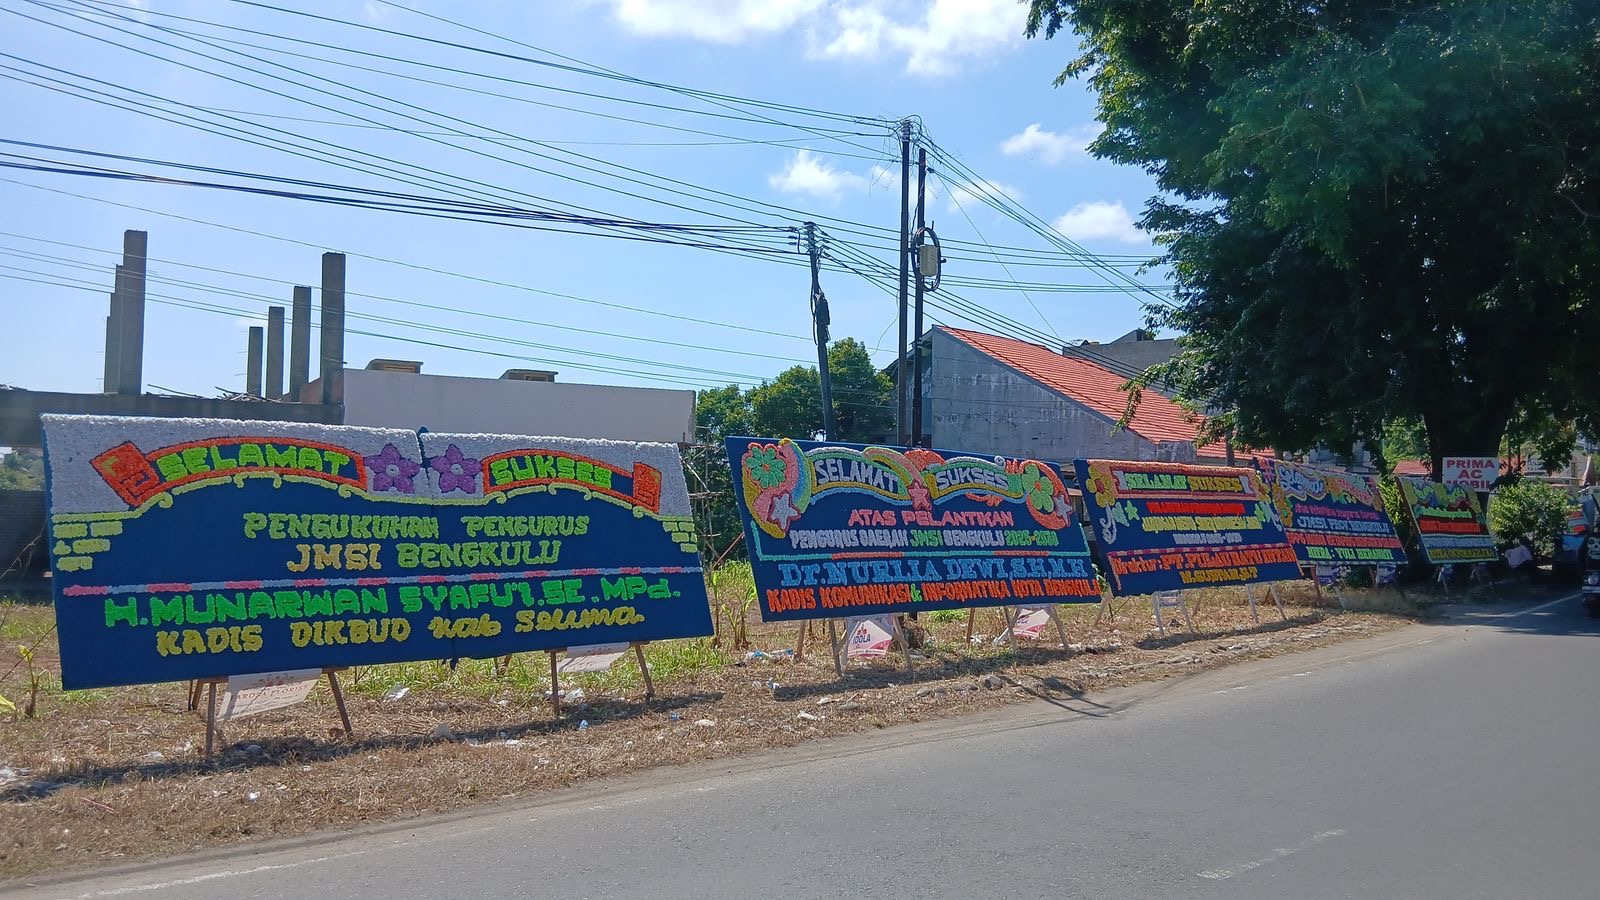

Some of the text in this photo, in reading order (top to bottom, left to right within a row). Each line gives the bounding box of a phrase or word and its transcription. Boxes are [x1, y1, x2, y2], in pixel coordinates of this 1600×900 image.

[156, 443, 612, 489] SELAMAT SUKSES
[814, 459, 1009, 493] SELAMAT SUKSES
[1446, 460, 1495, 468] PRIMA
[1457, 469, 1482, 479] AC
[243, 512, 590, 539] PENGUKUHAN PENGURUS
[848, 509, 1014, 526] ATAS PELANTIKAN
[789, 530, 859, 549] PENGURUS
[859, 529, 909, 548] DAERAH
[910, 529, 943, 547] JMSI
[943, 529, 1004, 547] BENGKULU
[287, 540, 561, 572] JMSI BENGKULU
[104, 588, 388, 627] H.MUNARWAN
[767, 578, 1103, 612] KADIS KOMUNIKASI & INFORMATIKA KOTA BENGKULU
[156, 624, 263, 656] KADIS
[290, 617, 411, 648] DIKBUD
[270, 684, 307, 697] FLORIST
